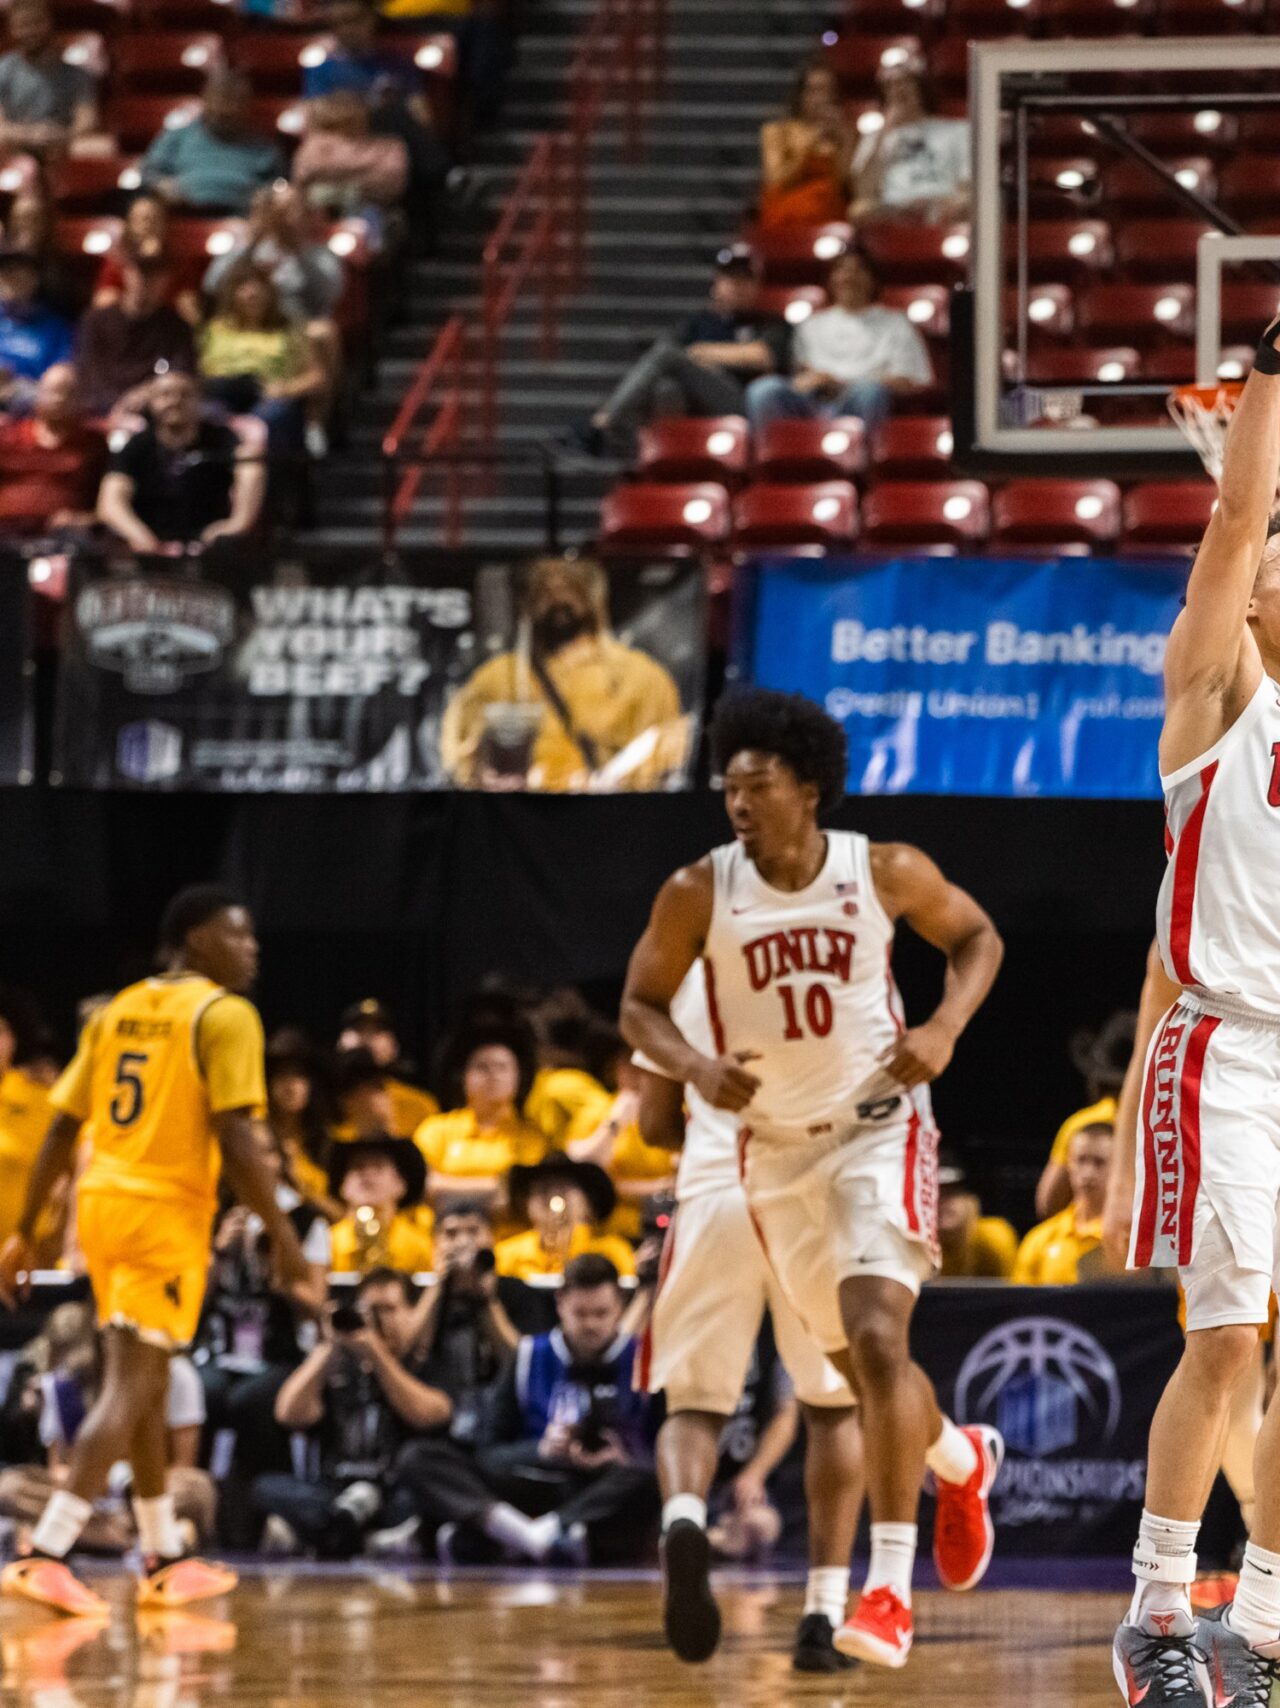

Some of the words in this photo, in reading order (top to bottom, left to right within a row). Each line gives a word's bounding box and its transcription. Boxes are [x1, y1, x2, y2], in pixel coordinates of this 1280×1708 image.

[251, 586, 470, 627] WHAT'S
[258, 627, 420, 660] YOUR
[831, 618, 976, 665] Better
[985, 620, 1166, 675] Banking
[249, 661, 431, 697] BEEF?
[741, 927, 856, 992] UNLV
[776, 982, 834, 1041] 10
[110, 1052, 149, 1127] 5
